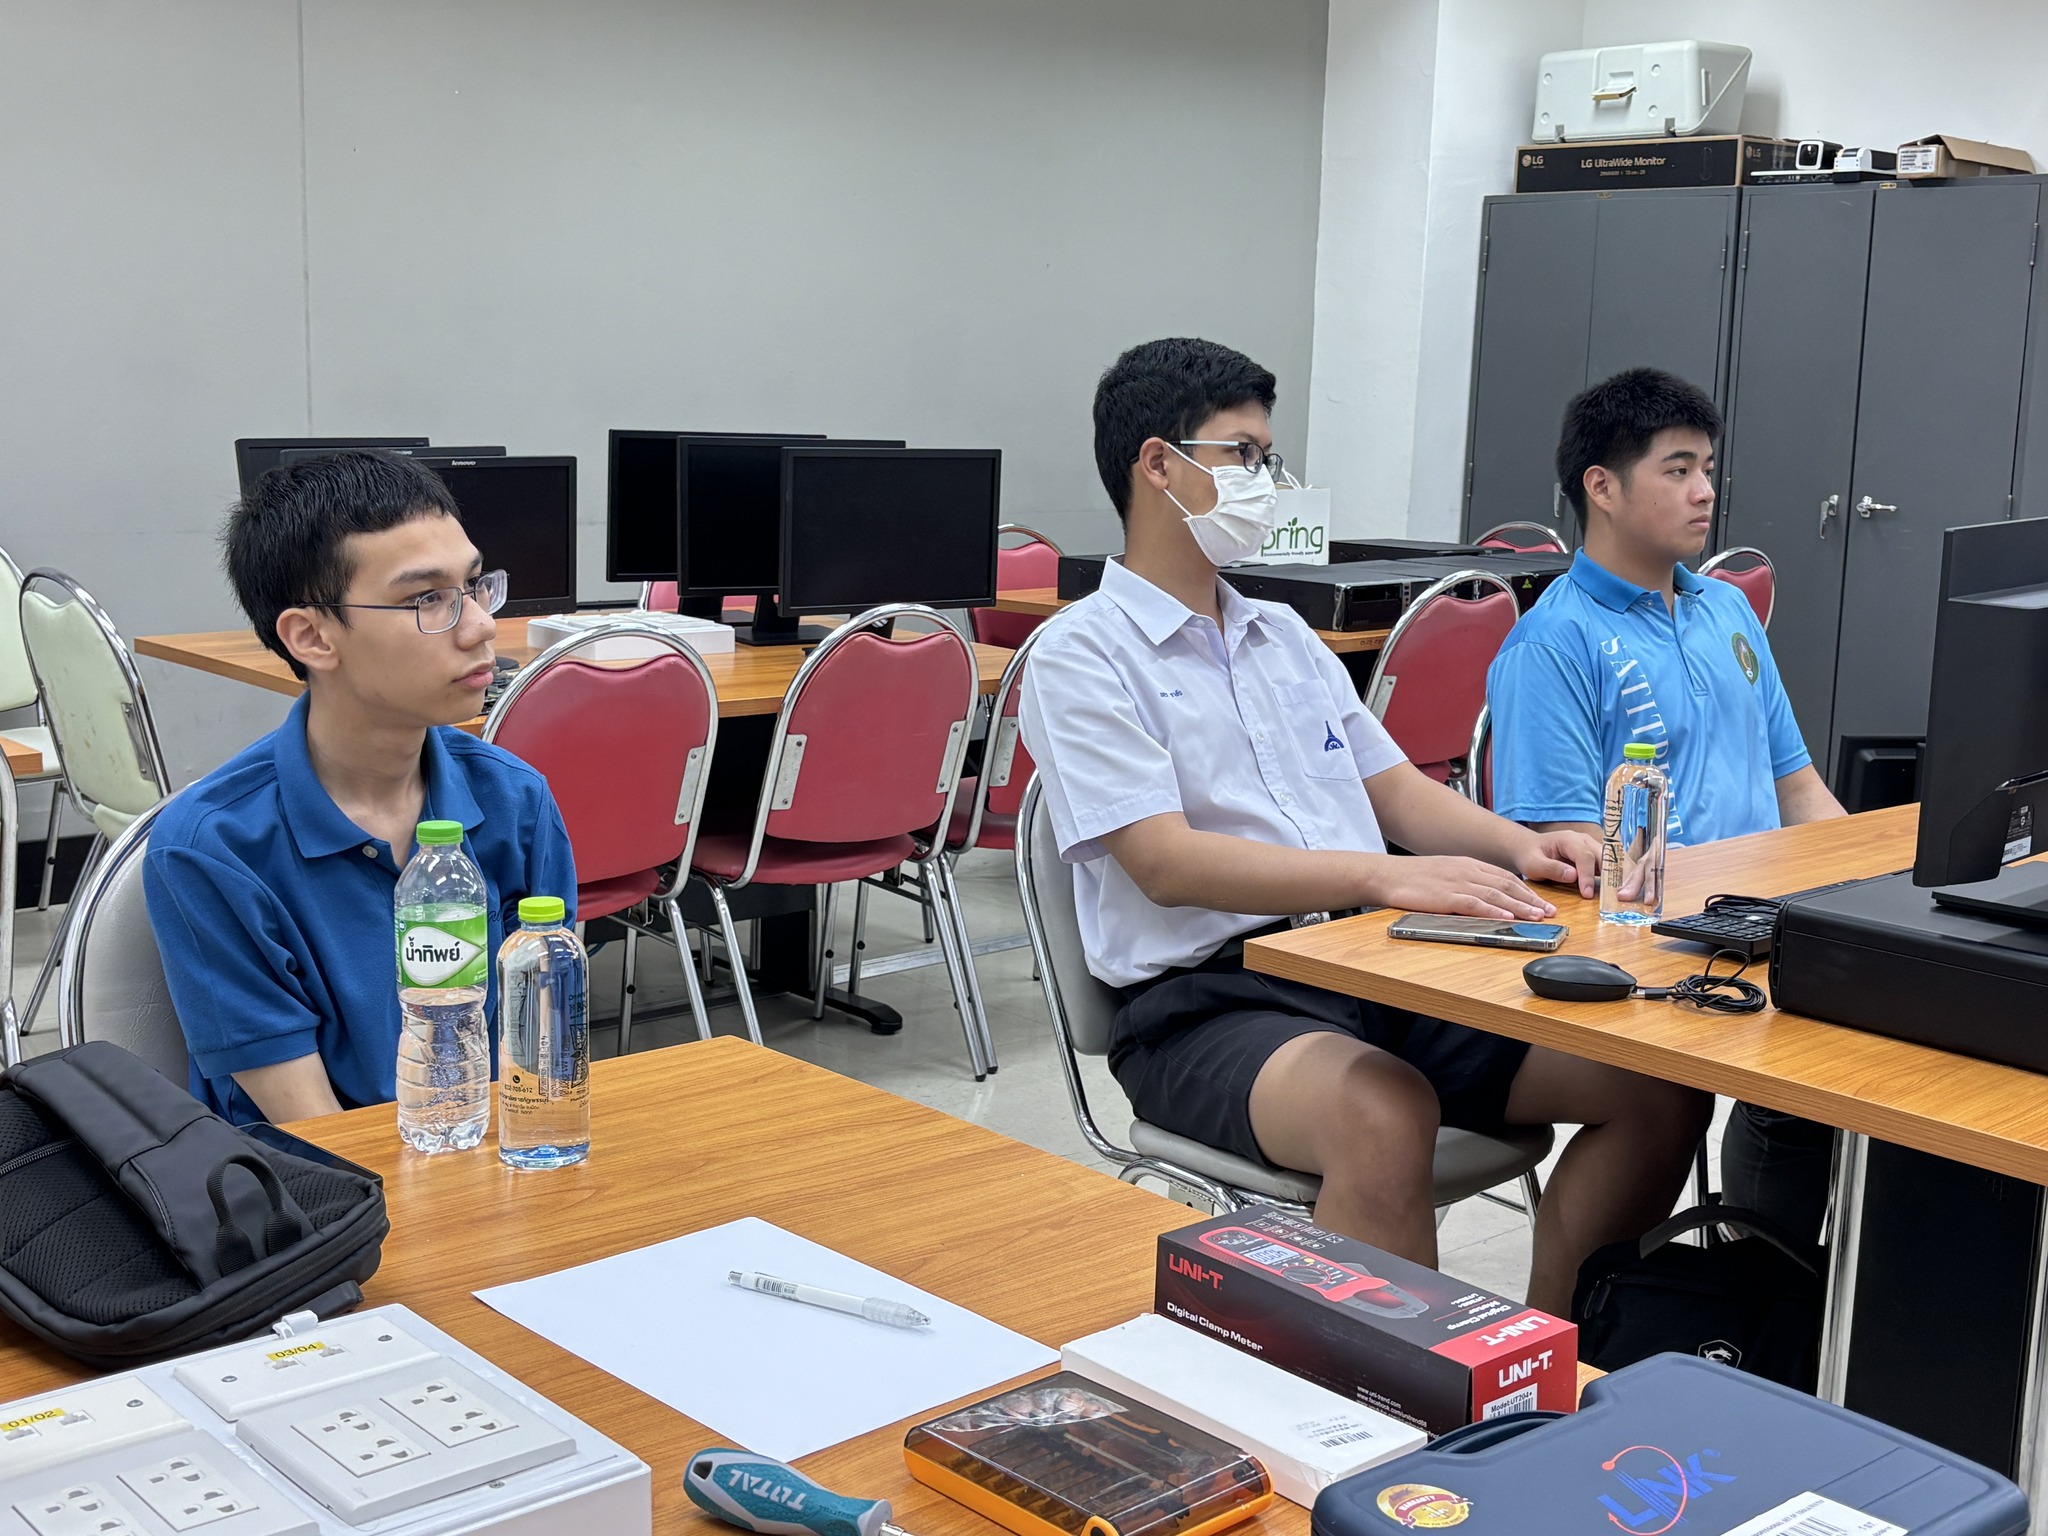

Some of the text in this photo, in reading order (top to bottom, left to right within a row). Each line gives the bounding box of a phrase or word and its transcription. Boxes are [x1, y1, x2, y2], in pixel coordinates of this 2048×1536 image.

[1532, 155, 1544, 165] LG
[1581, 156, 1667, 169] LG UltraWide Monitor
[1752, 148, 1762, 158] LG
[1600, 635, 1669, 738] SATIT
[405, 936, 461, 963] น้ำทิพย์
[1169, 1253, 1224, 1290] UNI-T
[1166, 1301, 1264, 1352] Digital Clamp Meter
[1446, 1304, 1512, 1330] Digital Clamp
[1480, 1315, 1550, 1346] UNI-T
[275, 1343, 317, 1358] 03/04
[1498, 1349, 1553, 1389] UNI-T
[1356, 1385, 1402, 1409] www.uni-trend.com
[8, 1410, 57, 1428] 01/02
[728, 1468, 807, 1511] TOTAL
